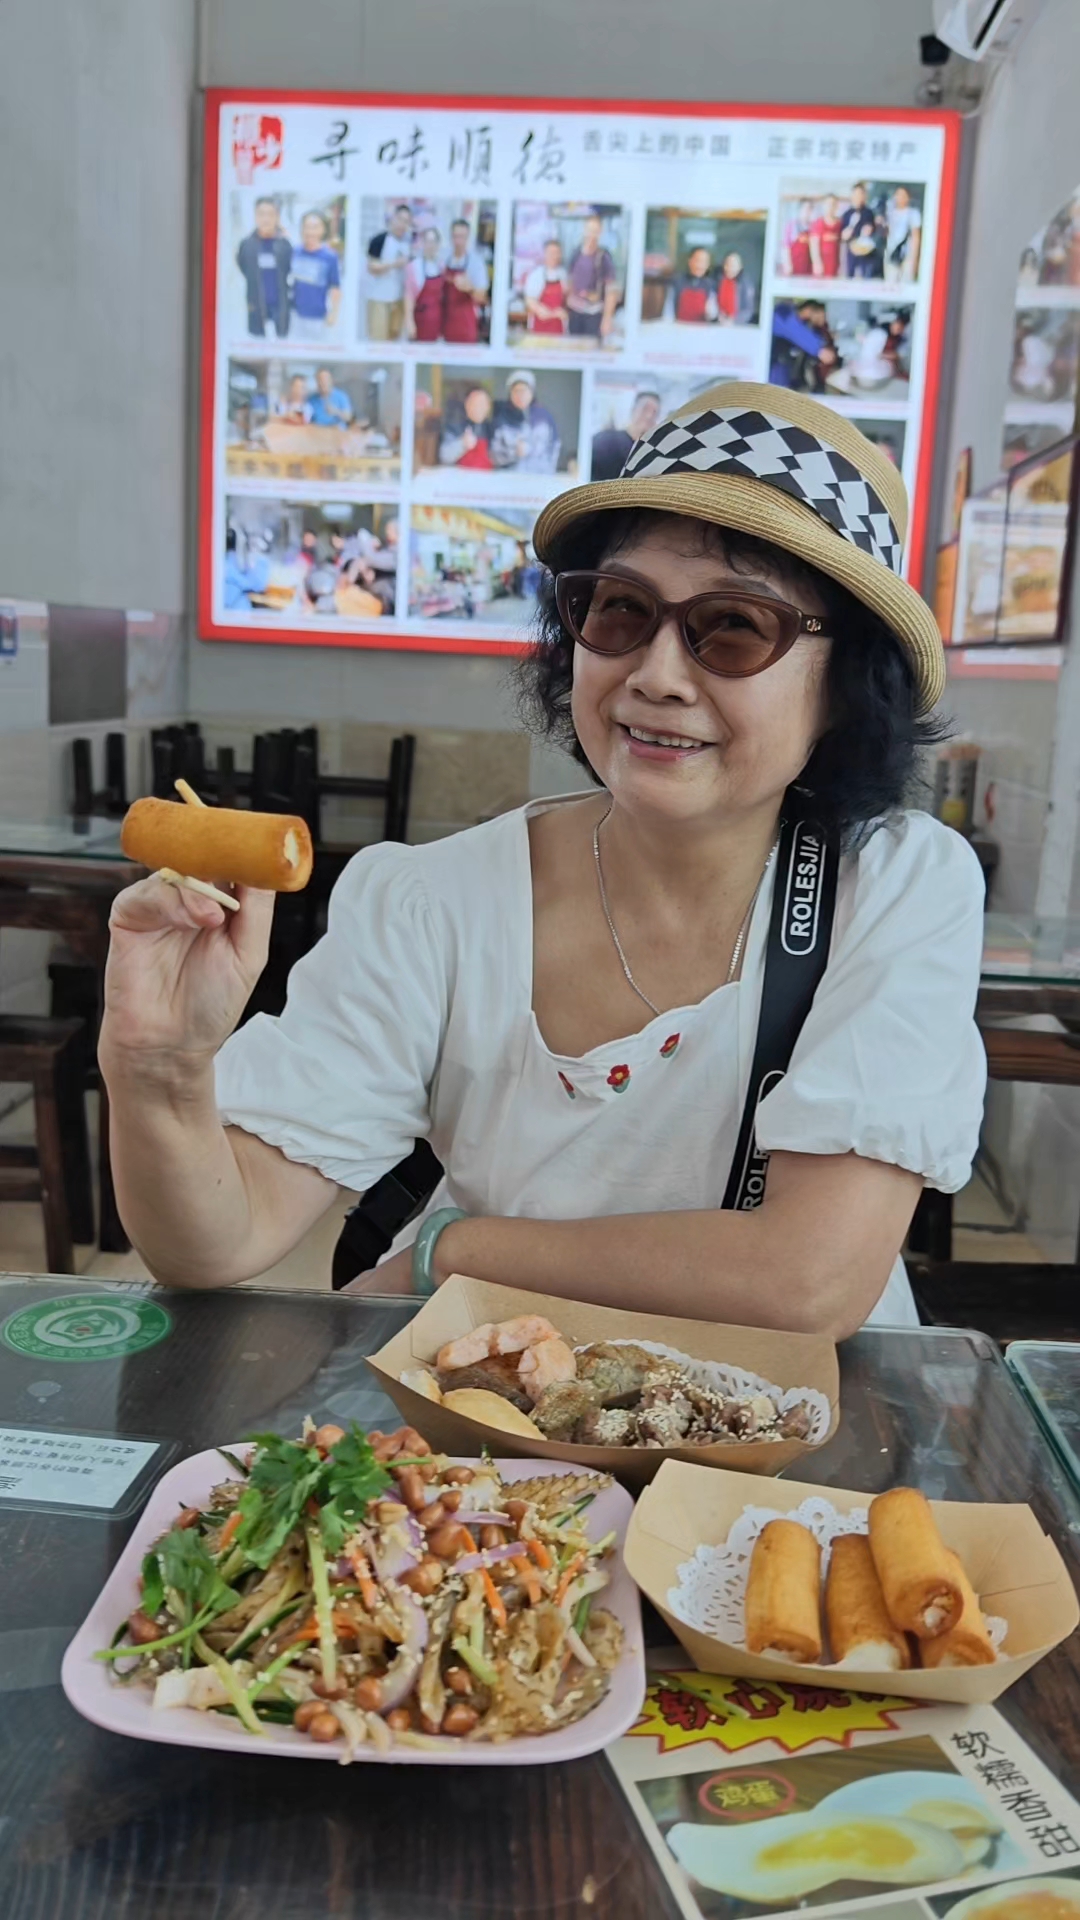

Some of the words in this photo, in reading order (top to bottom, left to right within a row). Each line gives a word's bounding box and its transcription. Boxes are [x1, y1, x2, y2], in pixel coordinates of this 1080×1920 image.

[741, 1145, 771, 1209] ROLE
[712, 1779, 779, 1808] 鸡蛋
[950, 1730, 1080, 1858] 软糯香甜
